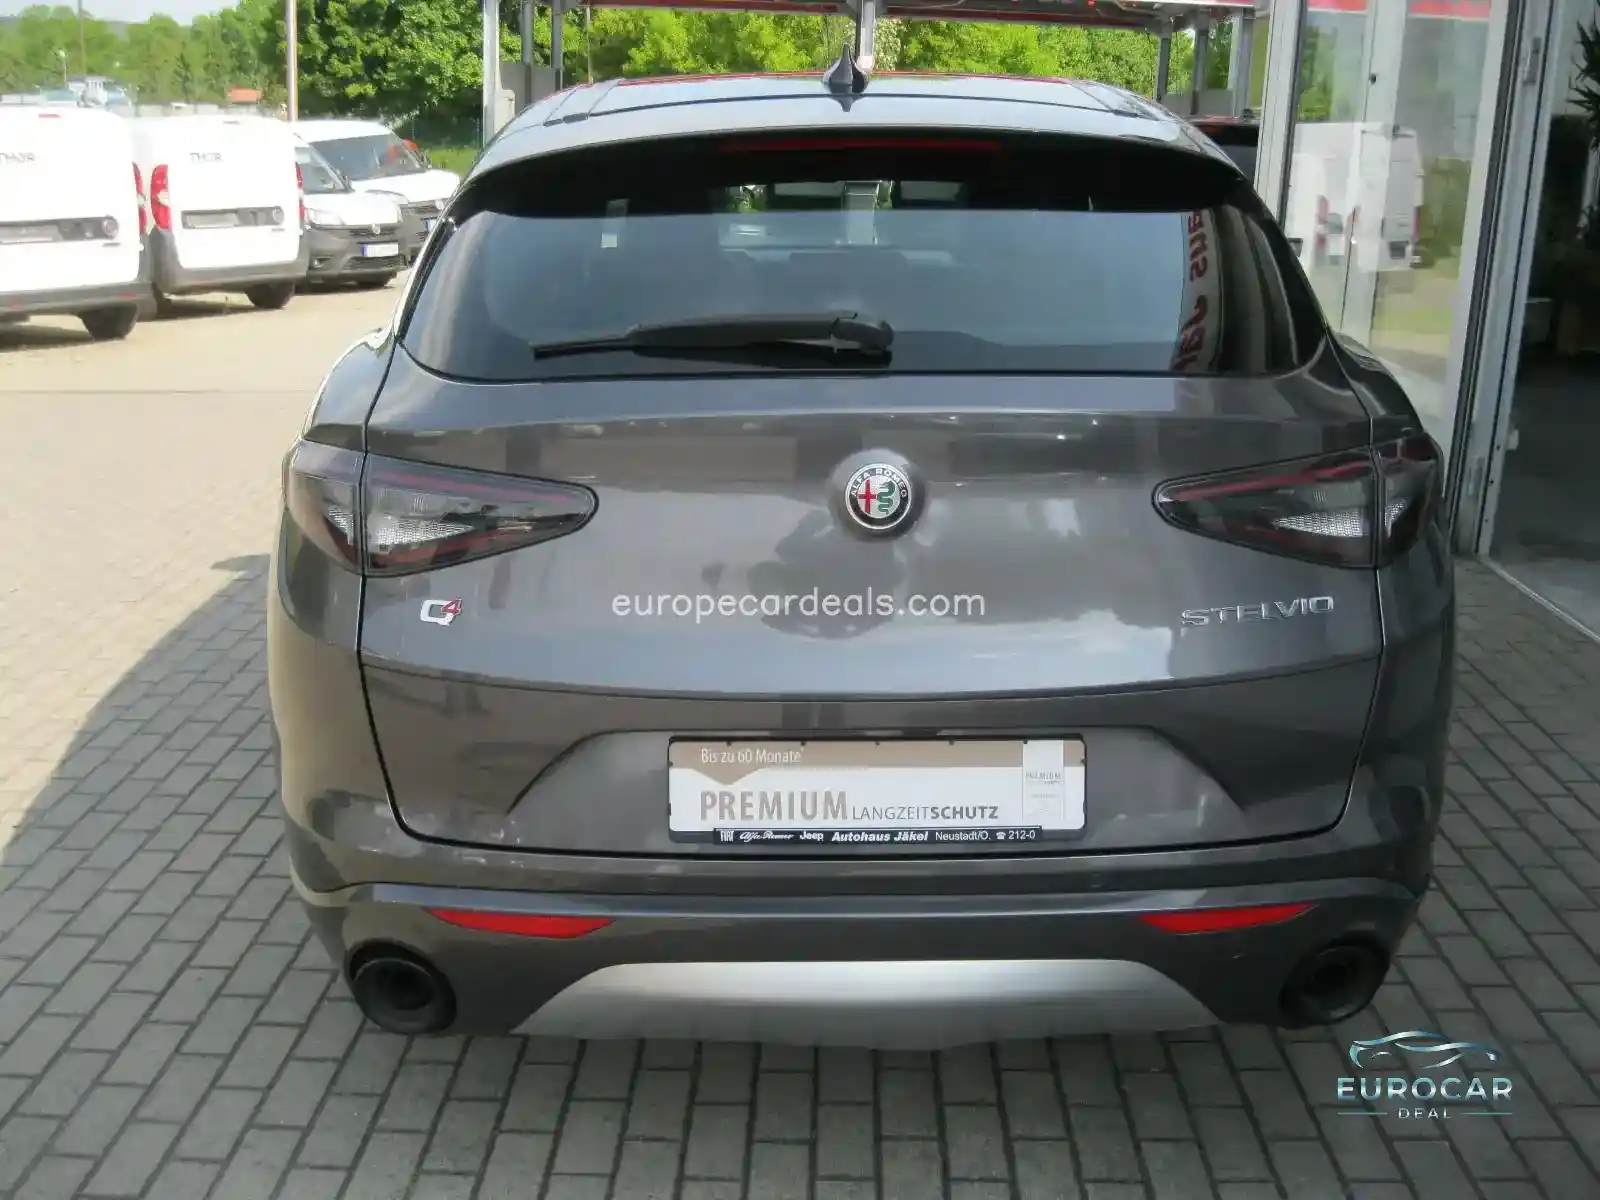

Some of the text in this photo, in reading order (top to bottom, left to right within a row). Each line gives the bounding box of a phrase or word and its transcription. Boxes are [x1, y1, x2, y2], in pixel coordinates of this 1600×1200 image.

[850, 468, 908, 498] ALFA ROMEO
[1181, 595, 1334, 627] STELVIO
[700, 748, 718, 763] Bis
[720, 752, 735, 763] zu
[737, 749, 753, 763] 60
[700, 790, 999, 821] PREMIUM LANGZEITSCHUTZ
[799, 830, 825, 842] Jeep
[832, 830, 891, 842] Autohaus
[894, 830, 929, 842] Jäkel
[1008, 830, 1036, 840] 212-0
